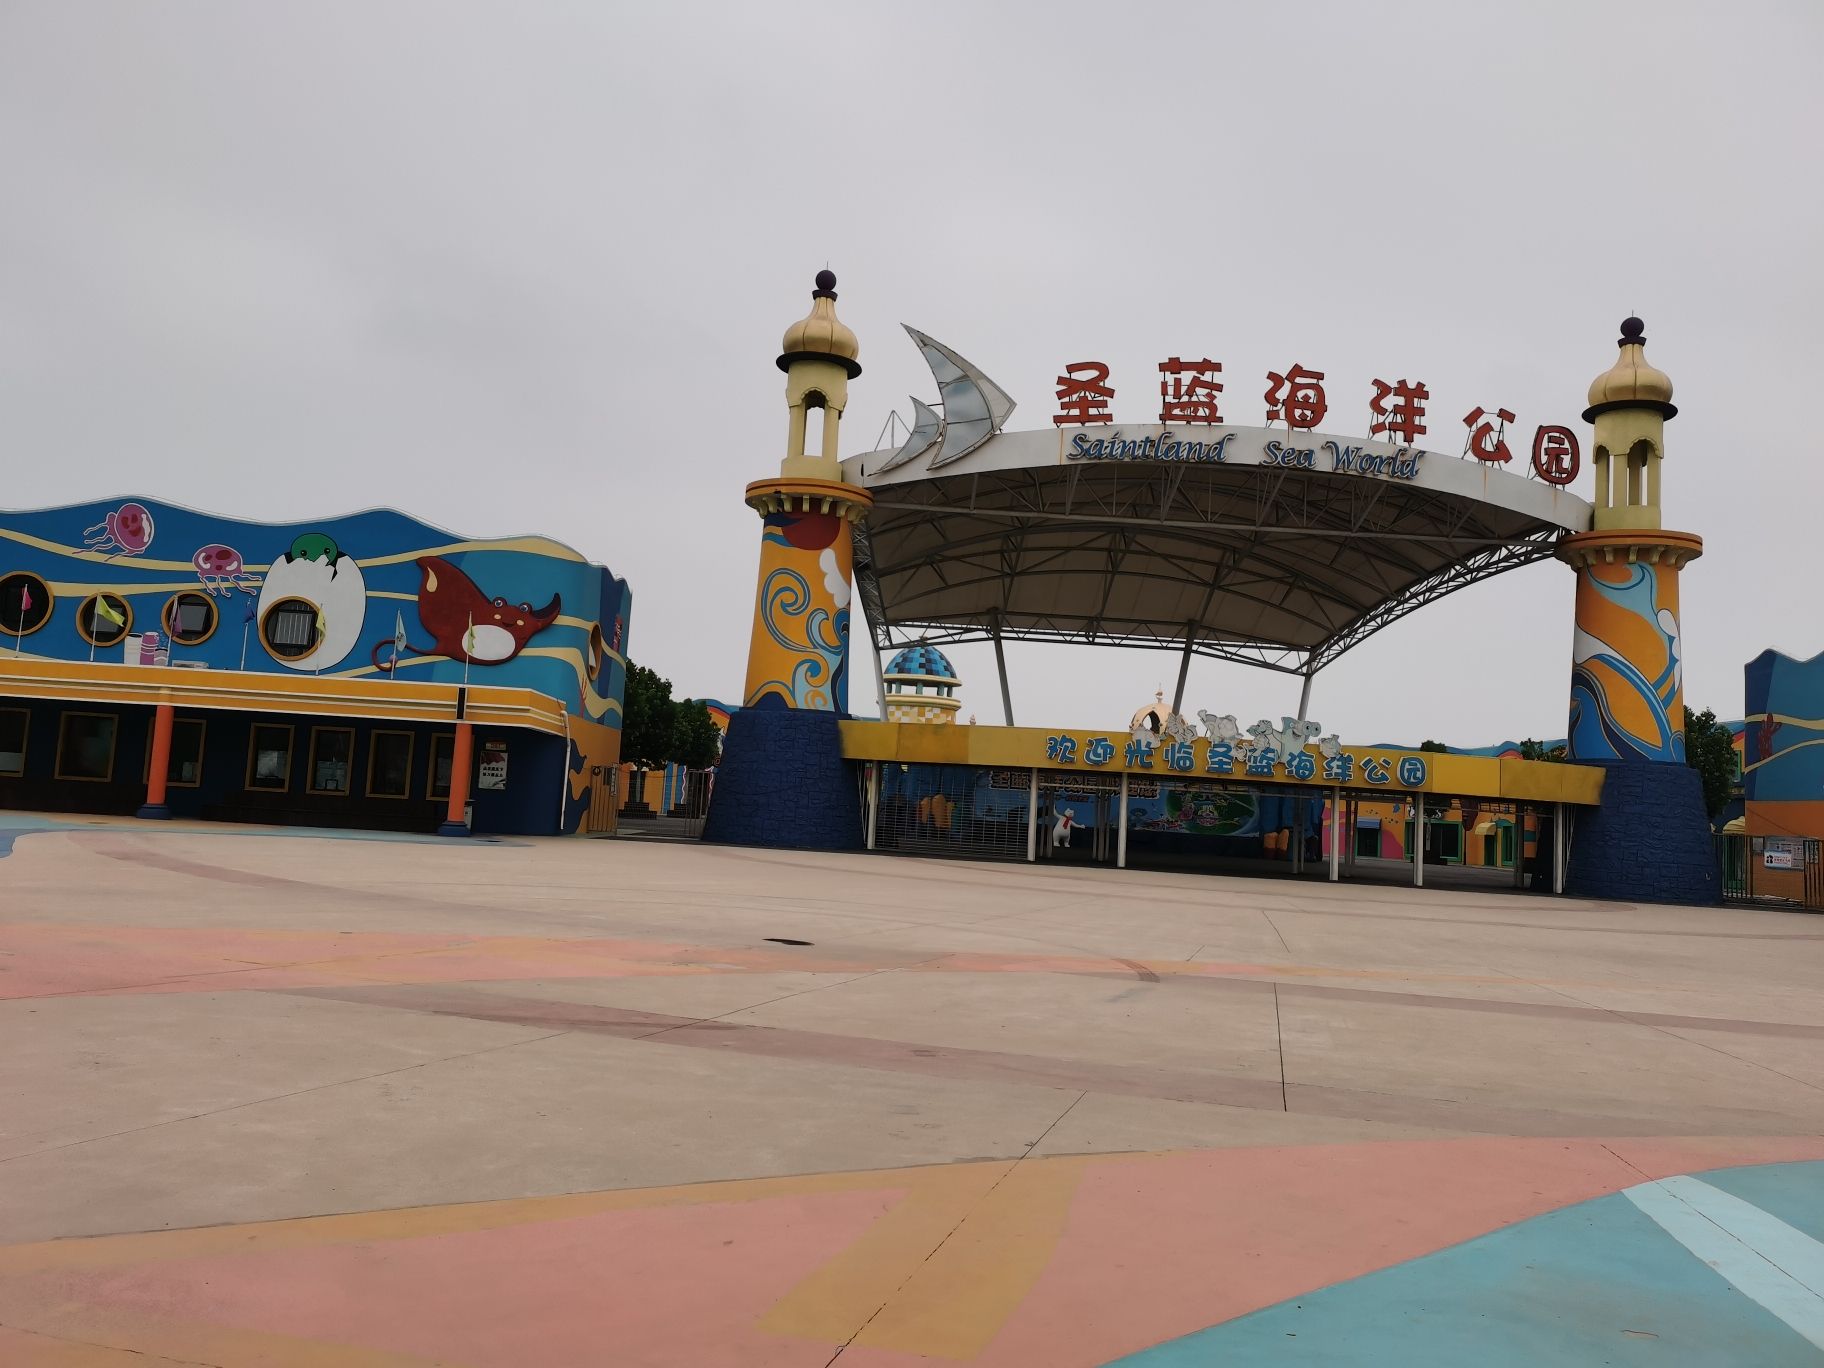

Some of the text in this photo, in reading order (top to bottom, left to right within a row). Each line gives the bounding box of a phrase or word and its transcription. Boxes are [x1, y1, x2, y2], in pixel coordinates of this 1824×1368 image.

[1053, 357, 1580, 485] 圣蓝海洋公园
[1066, 432, 1426, 480] Saintland Sea World
[1046, 735, 1427, 787] 欢迎光临圣蓝海洋公园
